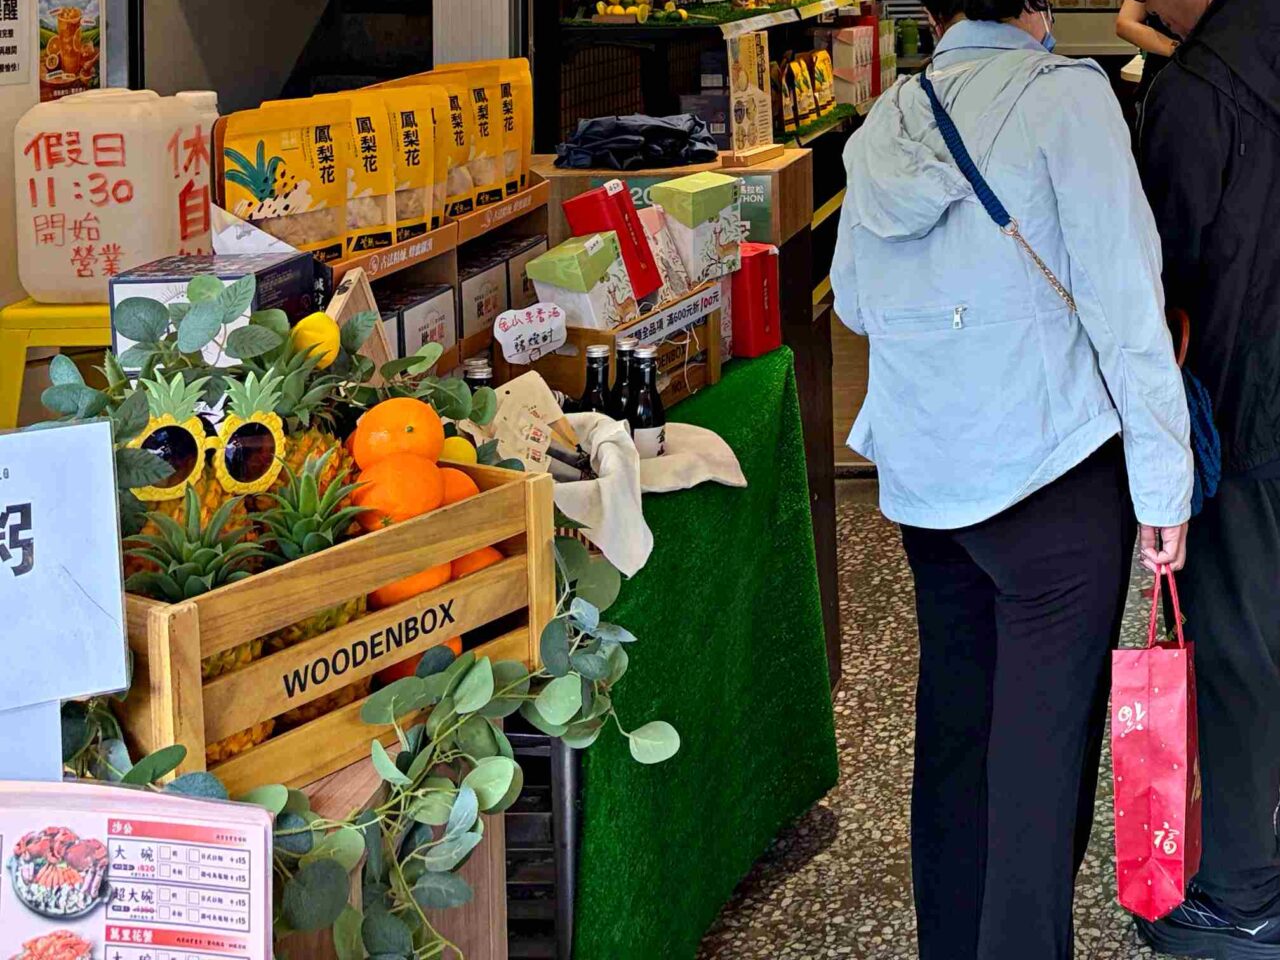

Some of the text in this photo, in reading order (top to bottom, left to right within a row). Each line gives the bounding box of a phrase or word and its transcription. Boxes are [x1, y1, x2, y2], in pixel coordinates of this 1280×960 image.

[23, 131, 126, 171] 假日
[315, 124, 335, 184] 鳳梨花
[356, 116, 378, 173] 鳳梨花
[400, 110, 420, 167] 鳳梨花
[28, 172, 134, 207] 11:30
[166, 123, 210, 256] 休自
[33, 212, 100, 247] 開始
[70, 243, 125, 278] 營業
[283, 599, 456, 699] WOODENBOX
